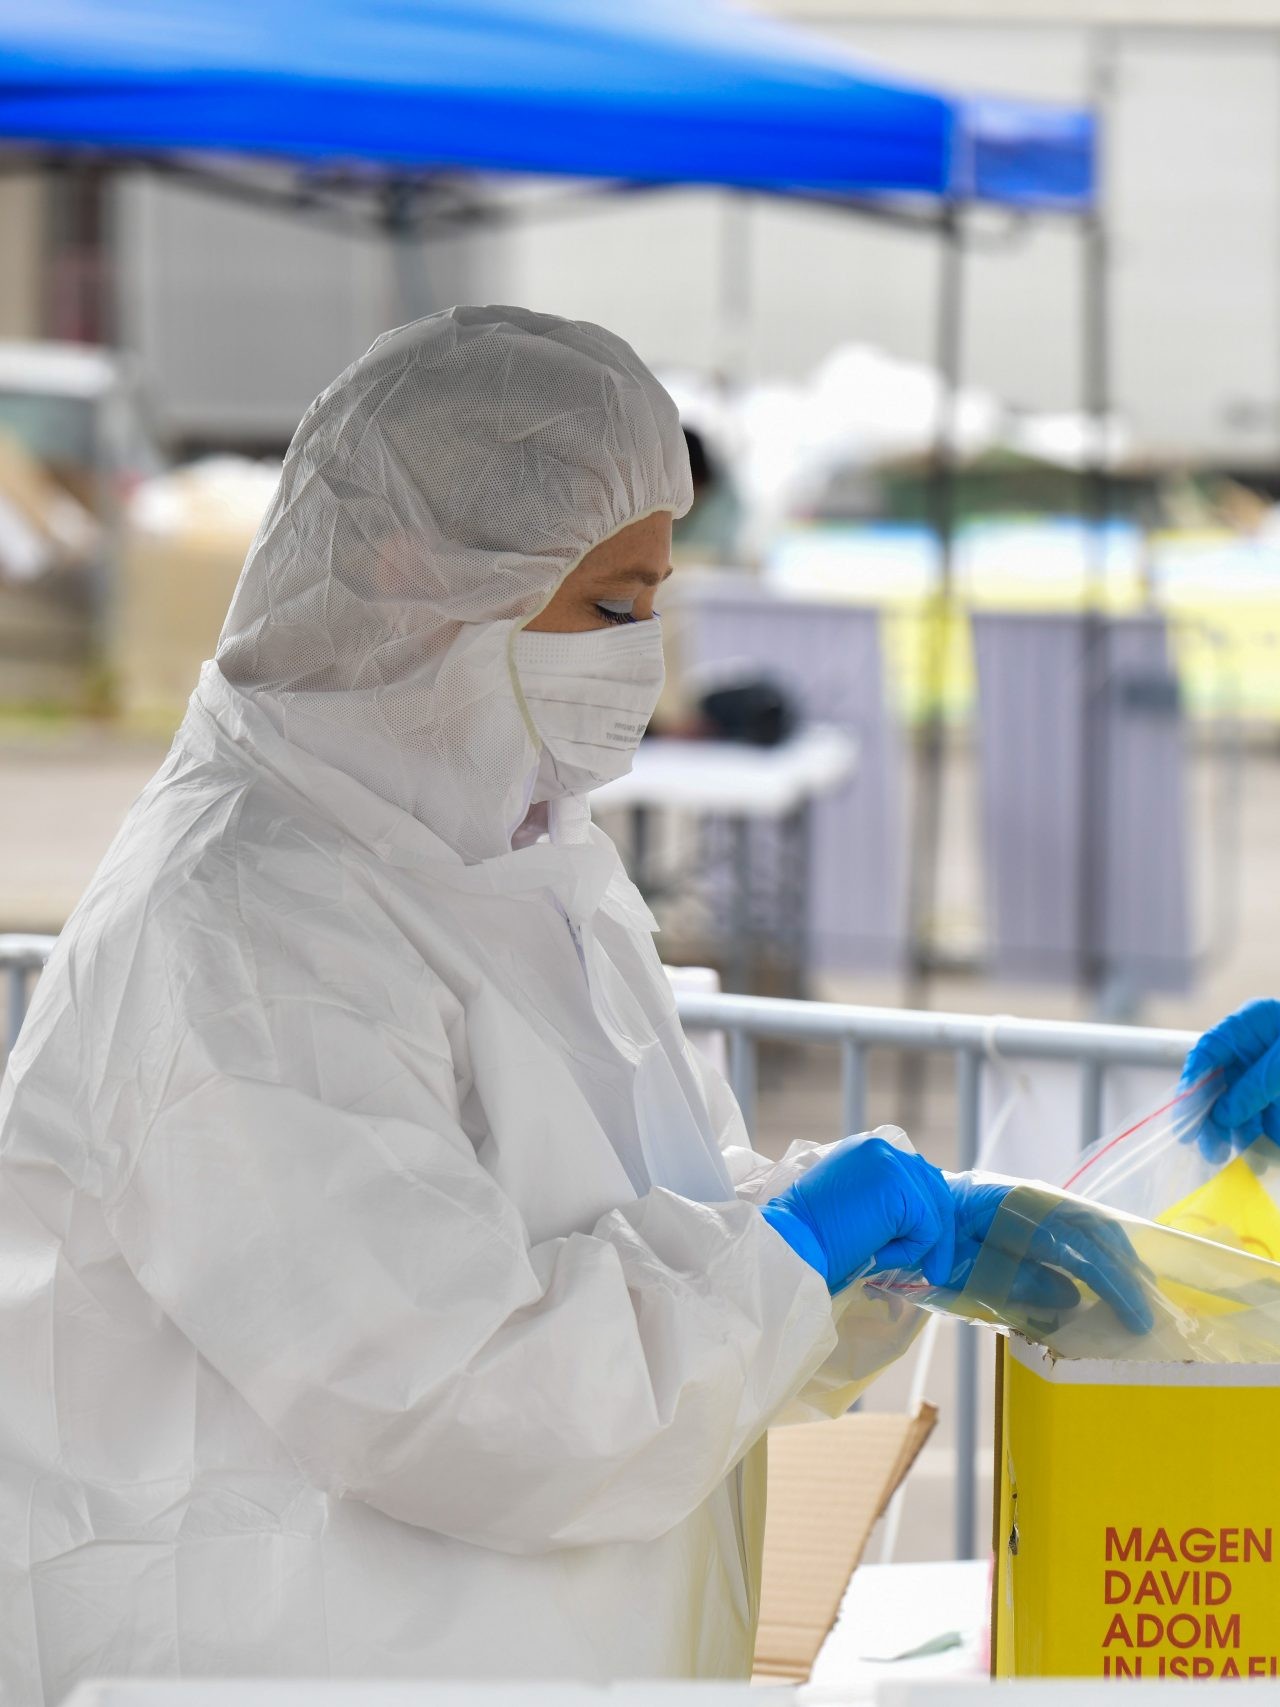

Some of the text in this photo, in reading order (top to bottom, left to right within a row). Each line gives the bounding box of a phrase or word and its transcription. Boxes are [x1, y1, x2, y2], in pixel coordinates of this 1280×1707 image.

[1104, 1526, 1273, 1563] MAGEN
[1104, 1569, 1232, 1606] DAVID
[1101, 1612, 1241, 1649] ADOM
[1103, 1655, 1142, 1680] IN
